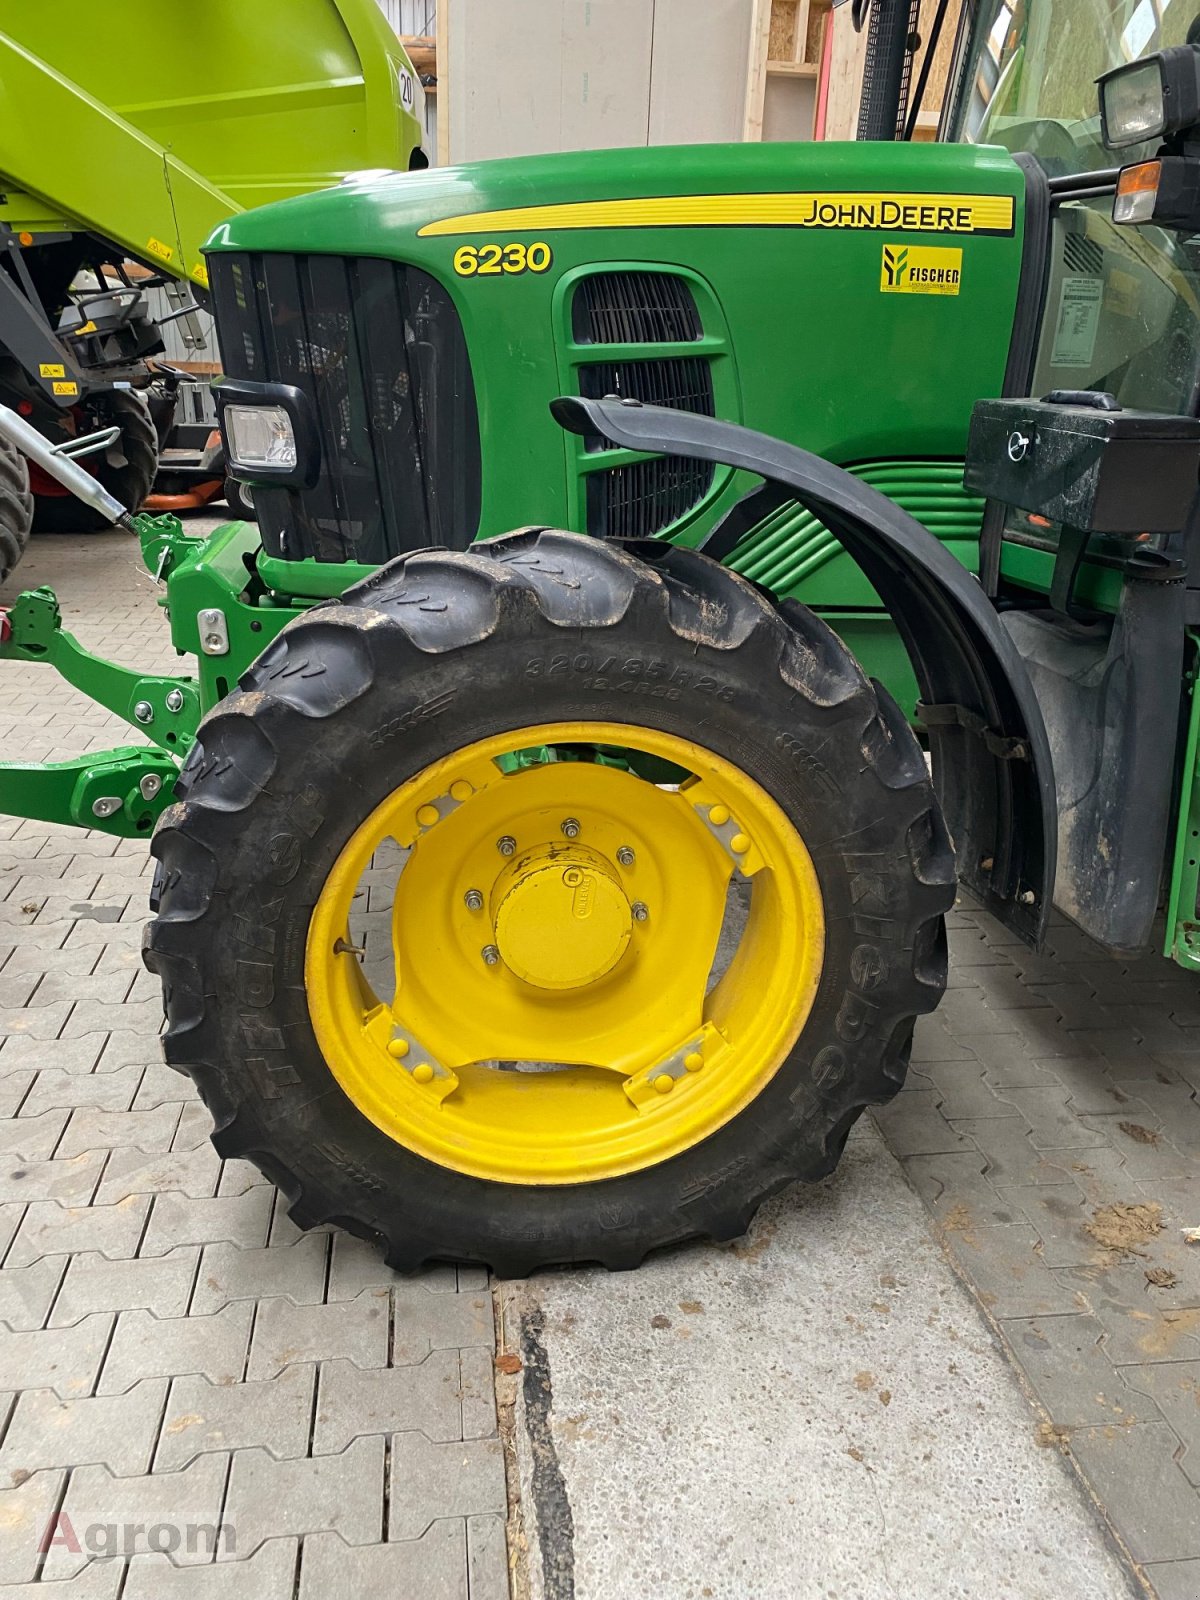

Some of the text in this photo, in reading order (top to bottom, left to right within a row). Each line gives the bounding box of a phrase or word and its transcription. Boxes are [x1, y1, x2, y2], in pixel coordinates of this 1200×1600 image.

[400, 73, 412, 104] 20
[803, 200, 973, 229] JOHN DEERE
[453, 242, 553, 277] 6230
[909, 267, 960, 284] FISCHER
